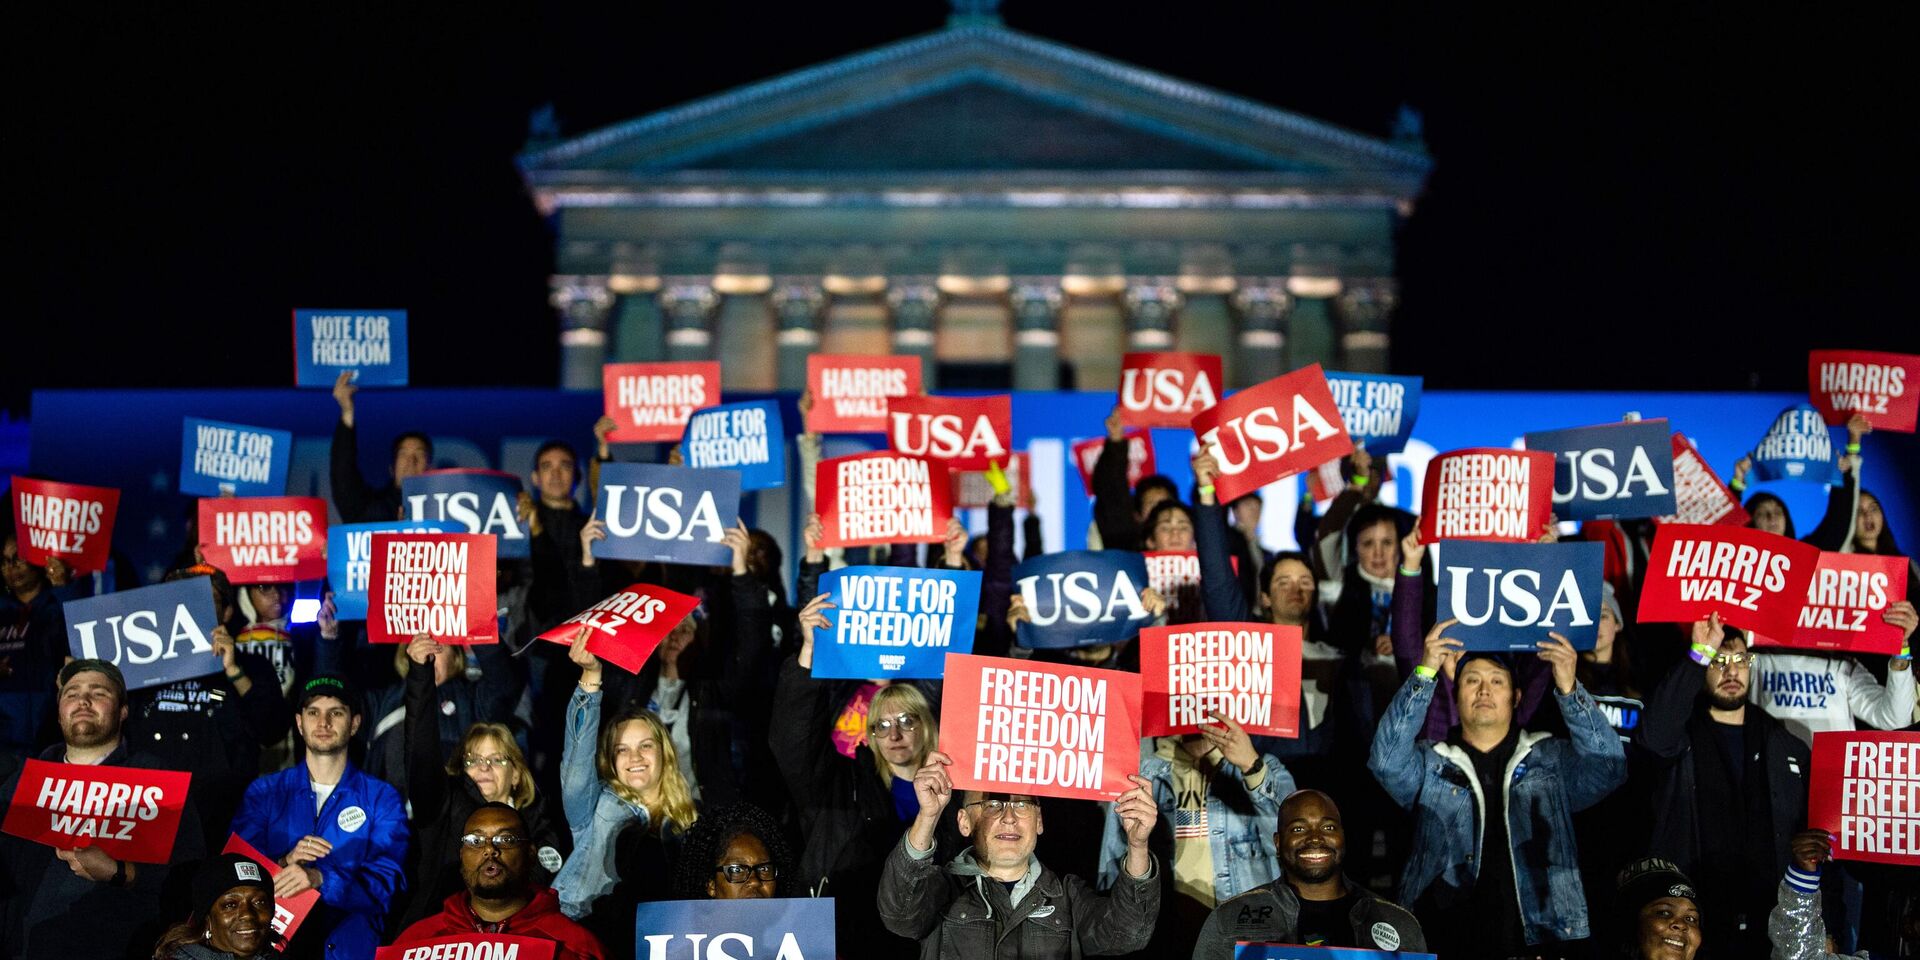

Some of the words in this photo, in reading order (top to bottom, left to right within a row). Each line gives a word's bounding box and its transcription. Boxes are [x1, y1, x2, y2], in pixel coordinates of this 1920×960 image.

[311, 315, 352, 340] VOTE
[355, 316, 390, 340] FOR
[312, 339, 390, 365] FREEDOM
[618, 374, 706, 407] HARRIS
[821, 368, 908, 399] HARRIS
[1122, 368, 1217, 414] USA
[1328, 379, 1362, 407] OTE
[1365, 381, 1405, 410] FOR
[1820, 362, 1906, 397] HARRIS
[834, 398, 888, 417] WAL
[1831, 393, 1888, 414] WALZ
[691, 411, 730, 441] VOTE
[732, 408, 767, 437] FOR
[891, 411, 1006, 458] USA
[1202, 394, 1339, 477] USA
[196, 425, 235, 452] VOTE
[239, 432, 273, 458] FOR
[689, 435, 769, 469] FREEDOM
[1757, 432, 1831, 462] FREEDOM
[194, 449, 272, 484] FREEDOM
[838, 457, 929, 486] FREEDOM
[1440, 454, 1530, 483] FREEDOM
[1554, 445, 1669, 504] USA
[838, 482, 931, 513] FREEDOM
[1438, 480, 1530, 510] FREEDOM
[20, 491, 103, 535] HARRIS
[215, 510, 313, 546] HARRIS
[407, 491, 525, 539] USA
[604, 485, 725, 543] USA
[839, 508, 933, 540] FREEDOM
[1435, 507, 1528, 538] FREEDOM
[29, 528, 86, 553] WALZ
[230, 545, 299, 566] WALZ
[387, 541, 468, 573] FREEDOM
[1666, 539, 1791, 593] HARRIS
[384, 573, 467, 605] FREEDOM
[840, 575, 903, 613] VOTE
[908, 577, 957, 614] FOR
[1017, 570, 1150, 626] USA
[1447, 565, 1594, 627] USA
[1680, 579, 1763, 611] WALZ
[74, 603, 213, 667] USA
[384, 604, 468, 637] FREEDOM
[837, 610, 954, 647] FREEDOM
[1168, 630, 1273, 664] FREEDOM
[978, 667, 1107, 715] FREEDOM
[1168, 662, 1273, 697] FREEDOM
[1762, 670, 1836, 695] HARRIS
[1168, 694, 1272, 727] FREEDOM
[1774, 692, 1827, 709] WALZ
[976, 704, 1105, 752] FREEDOM
[973, 742, 1103, 790] FREEDOM
[36, 777, 163, 821] HARRIS
[50, 813, 137, 841] WALZ
